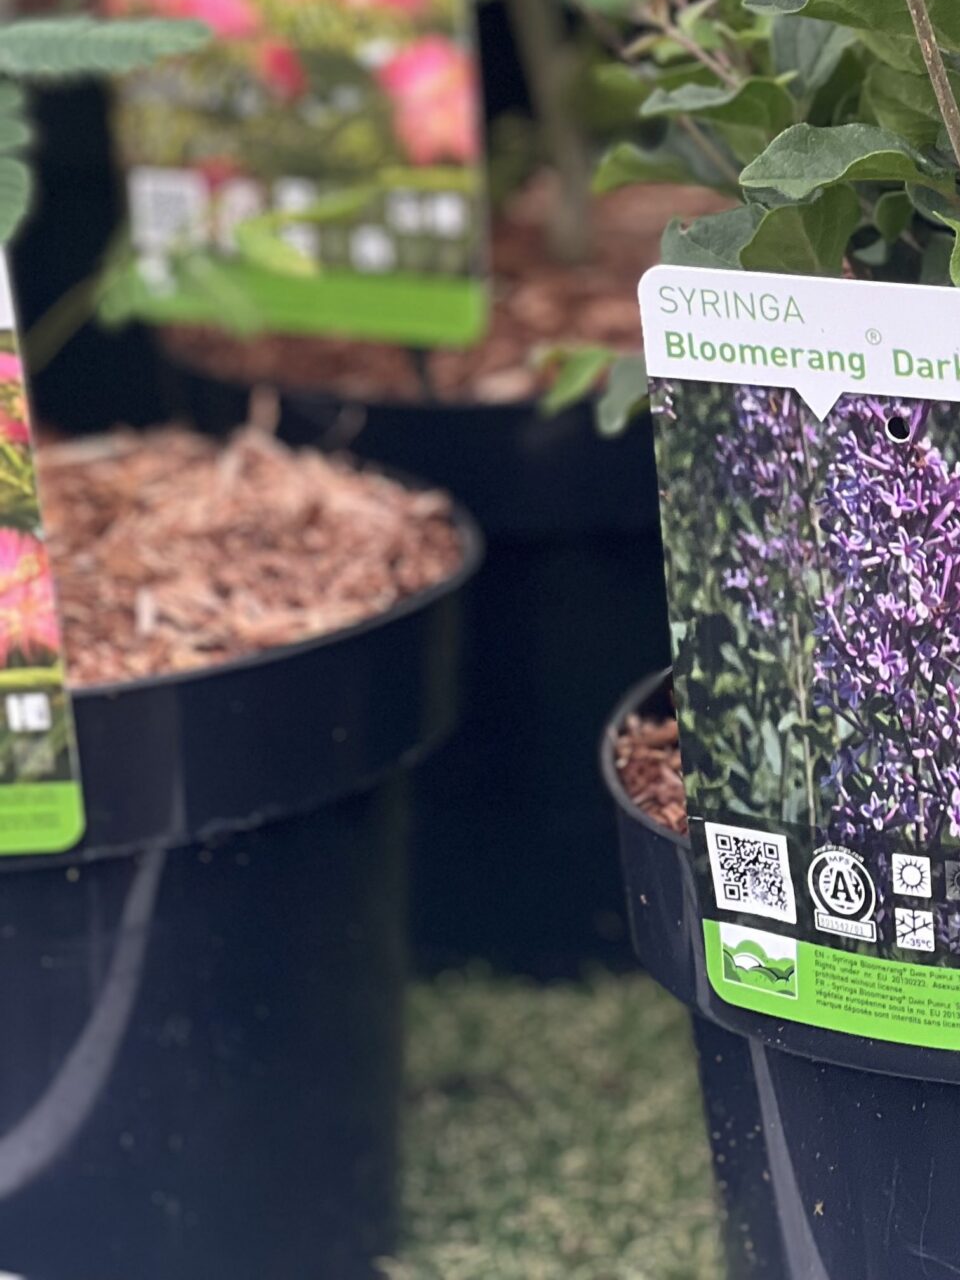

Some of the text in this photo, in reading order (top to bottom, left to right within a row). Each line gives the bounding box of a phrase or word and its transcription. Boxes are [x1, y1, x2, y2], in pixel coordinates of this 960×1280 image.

[658, 286, 805, 324] SYRINGA
[830, 870, 854, 903] A
[877, 973, 888, 982] EU
[930, 1009, 941, 1018] EU
